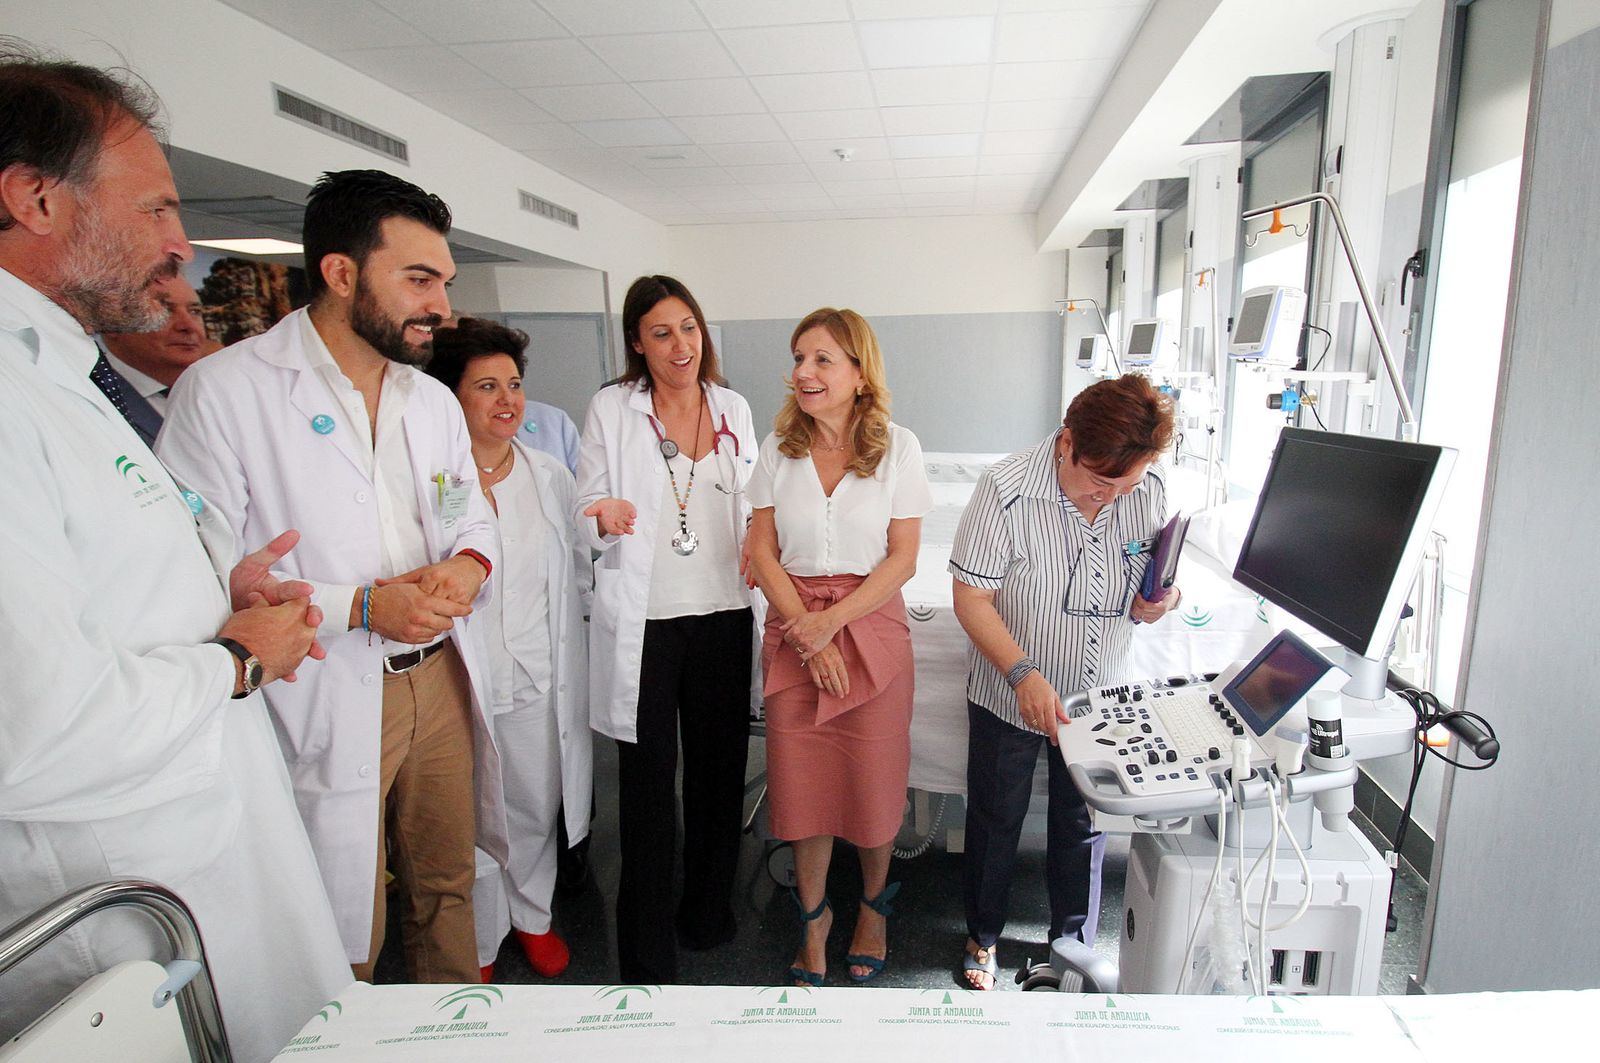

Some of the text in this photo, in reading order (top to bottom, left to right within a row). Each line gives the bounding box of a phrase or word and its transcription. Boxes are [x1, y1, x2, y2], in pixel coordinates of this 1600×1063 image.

[741, 1007, 764, 1017] JUNTA
[766, 1007, 776, 1016] DE
[907, 1006, 931, 1016] JUNTA
[932, 1007, 942, 1016] DE
[1074, 1010, 1098, 1020] JUNTA
[1099, 1010, 1108, 1020] DE
[576, 1015, 601, 1024] JUNTA
[602, 1014, 614, 1022] DE
[1242, 1016, 1267, 1026] JUNTA
[410, 1024, 435, 1034] JUNTA
[435, 1023, 448, 1032] DE
